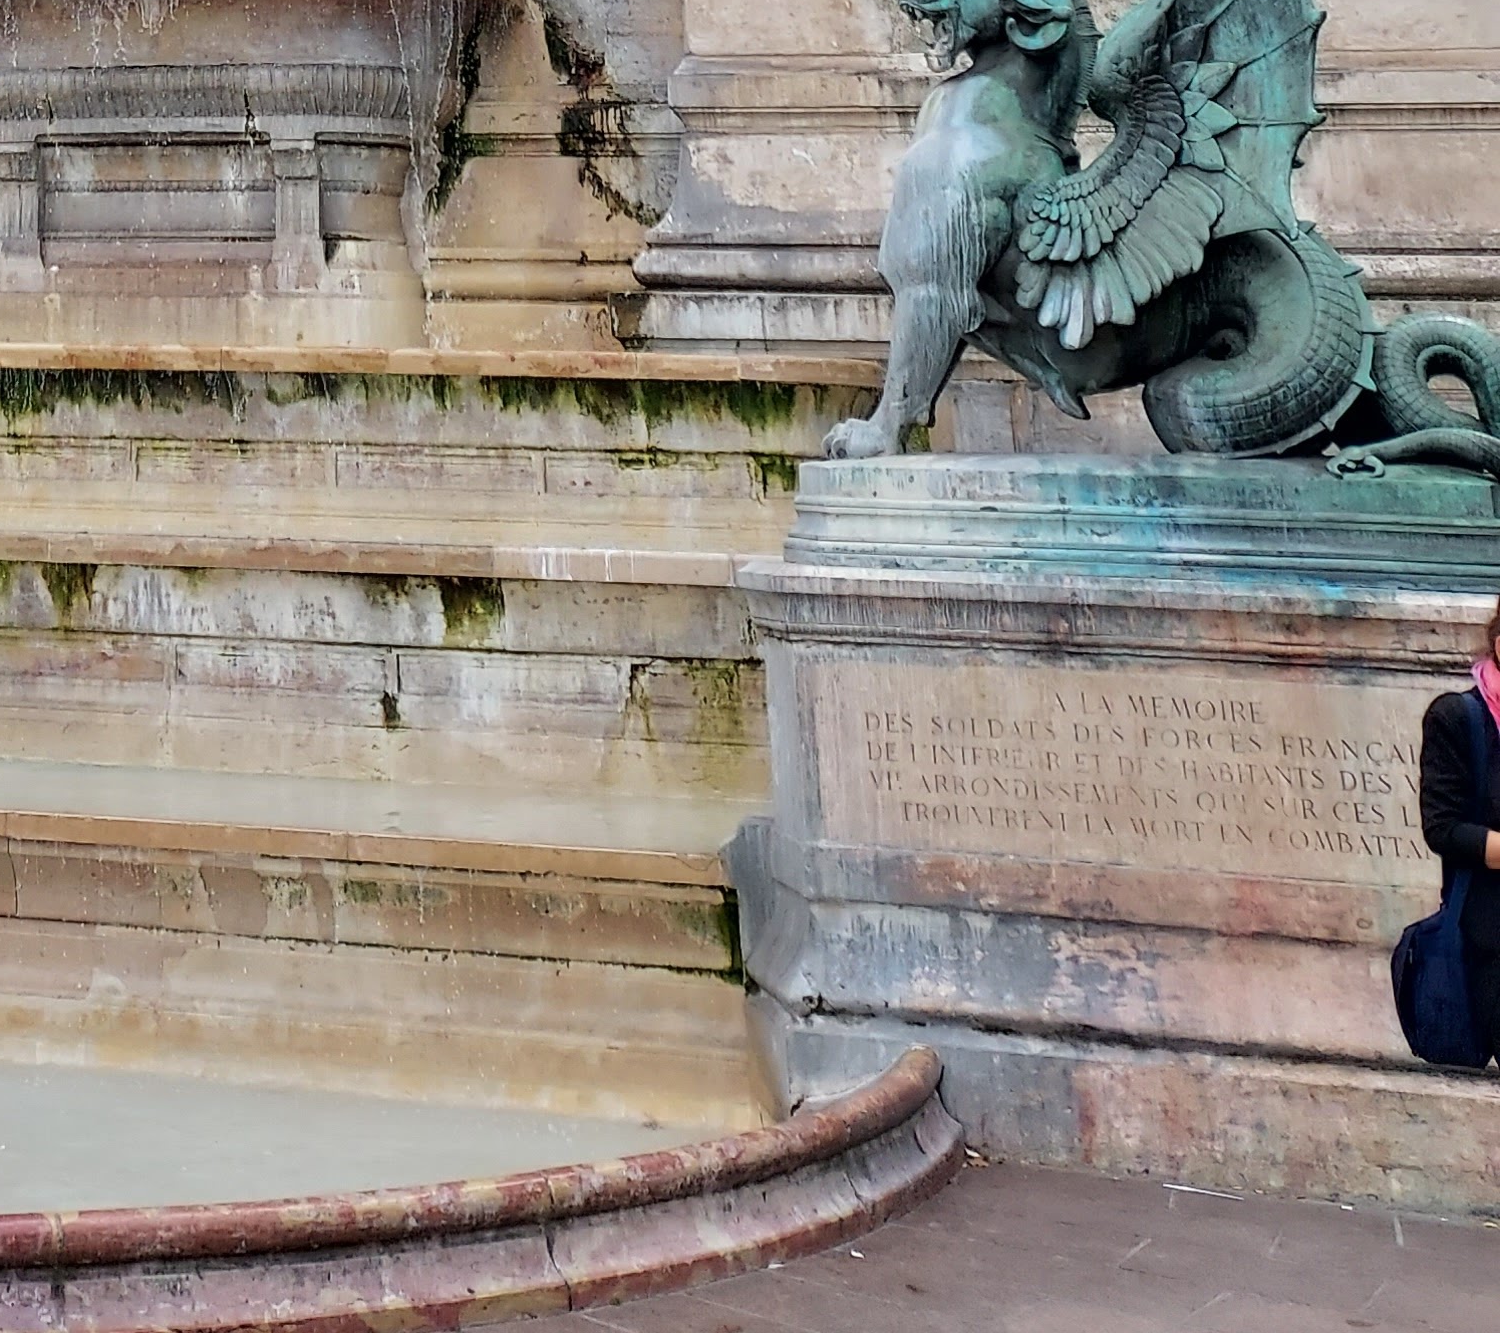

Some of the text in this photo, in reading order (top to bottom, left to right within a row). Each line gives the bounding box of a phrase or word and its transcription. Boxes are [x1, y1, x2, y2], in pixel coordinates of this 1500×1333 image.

[1081, 691, 1112, 715] LA
[1127, 693, 1268, 725] MEMOIRE
[864, 711, 1416, 766] DES SOLDATS DES FORCES FRANÇAI
[866, 740, 899, 763] DE
[1075, 753, 1103, 774] ET
[1118, 756, 1166, 777] DES
[1181, 760, 1325, 790] HABITANTS
[1339, 770, 1392, 794] DES
[901, 802, 1066, 832] TROUVERENT
[1085, 813, 1115, 836] LA
[1129, 817, 1205, 842] MORT
[1220, 824, 1253, 844] EN
[919, 774, 1178, 808] ARRONDISSEMENTS
[1196, 791, 1247, 814] QUI
[1263, 797, 1317, 820] SUR
[1332, 801, 1385, 824] CES
[1401, 805, 1417, 828] L
